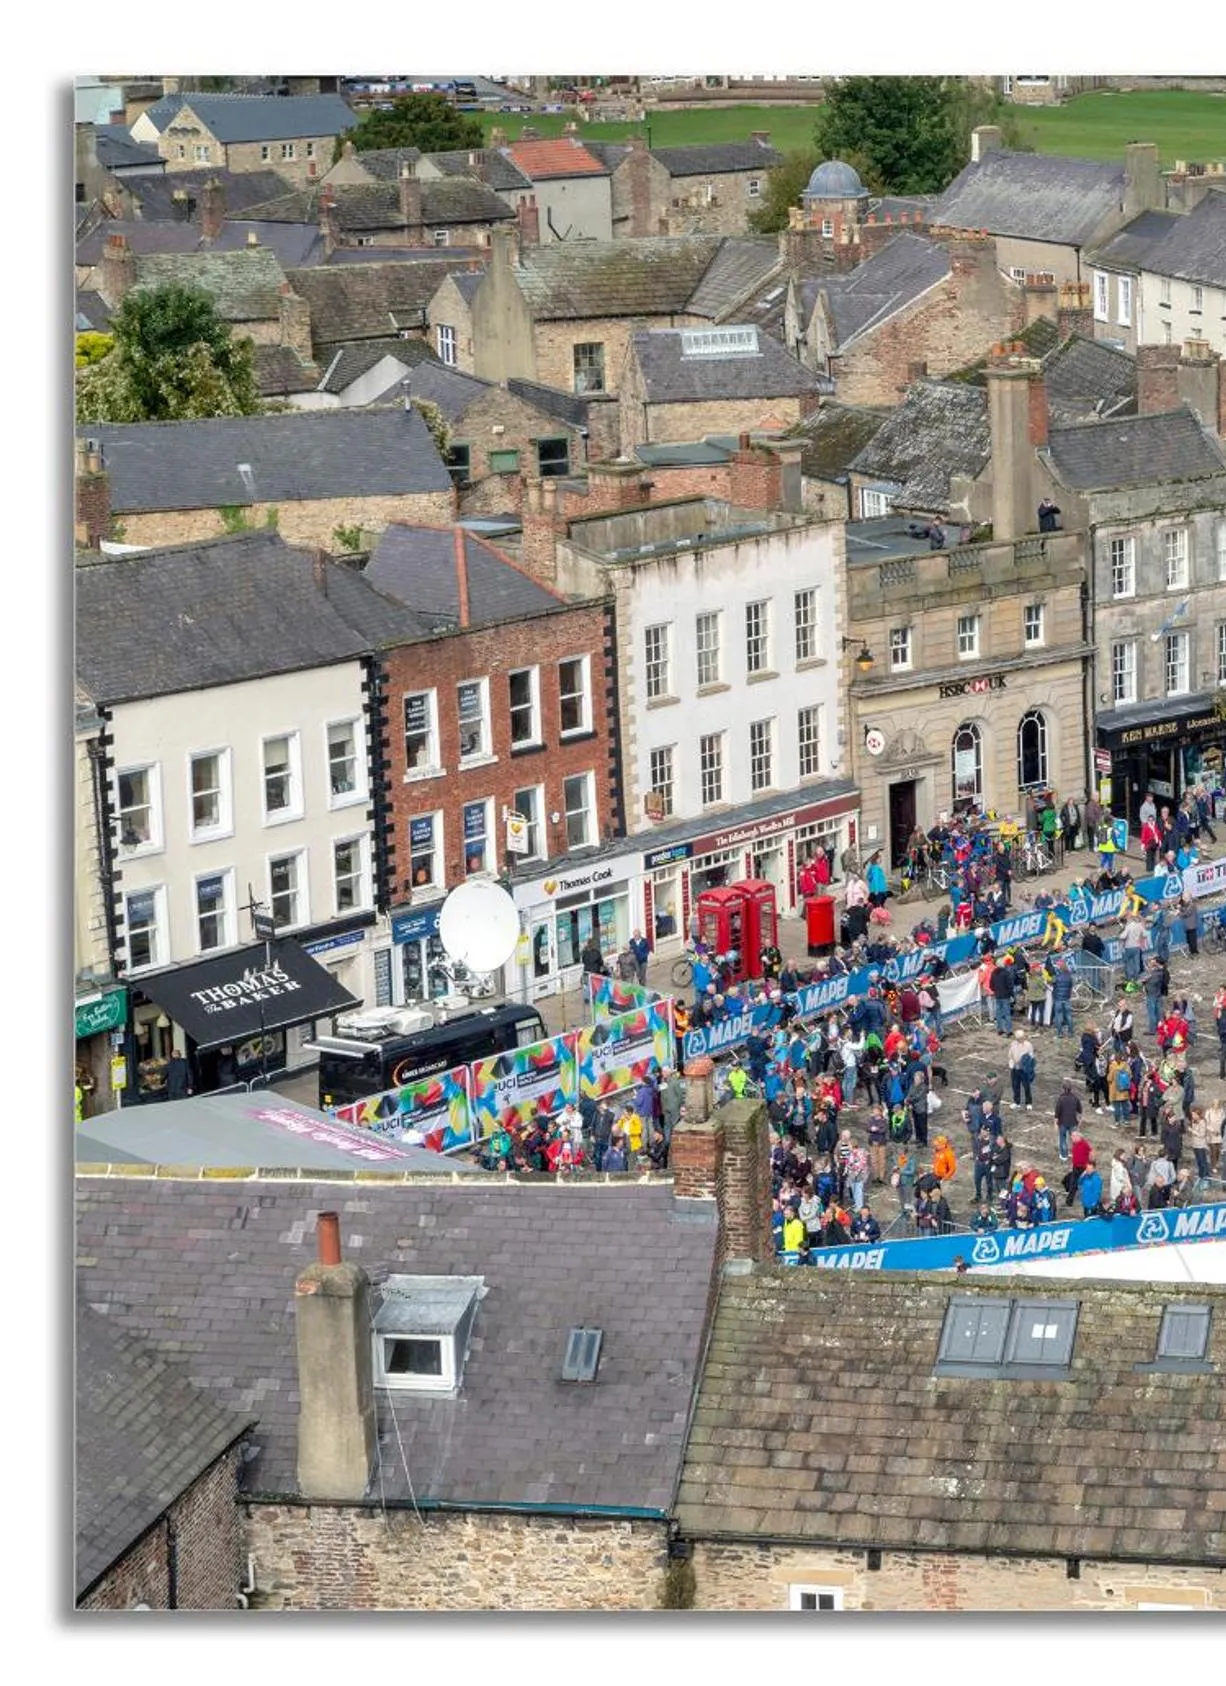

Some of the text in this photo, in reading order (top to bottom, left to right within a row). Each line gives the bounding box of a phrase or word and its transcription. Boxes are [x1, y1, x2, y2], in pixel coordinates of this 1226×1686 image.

[940, 673, 1007, 698] HSBC UK
[560, 868, 613, 891] Thomas Cook
[999, 912, 1043, 946] MAPEI
[190, 968, 289, 1005] THOMAS
[220, 980, 302, 1009] BAKER
[805, 976, 849, 1012] MAPEI
[498, 1074, 516, 1091] UCI
[1004, 1228, 1071, 1257] MAPEI
